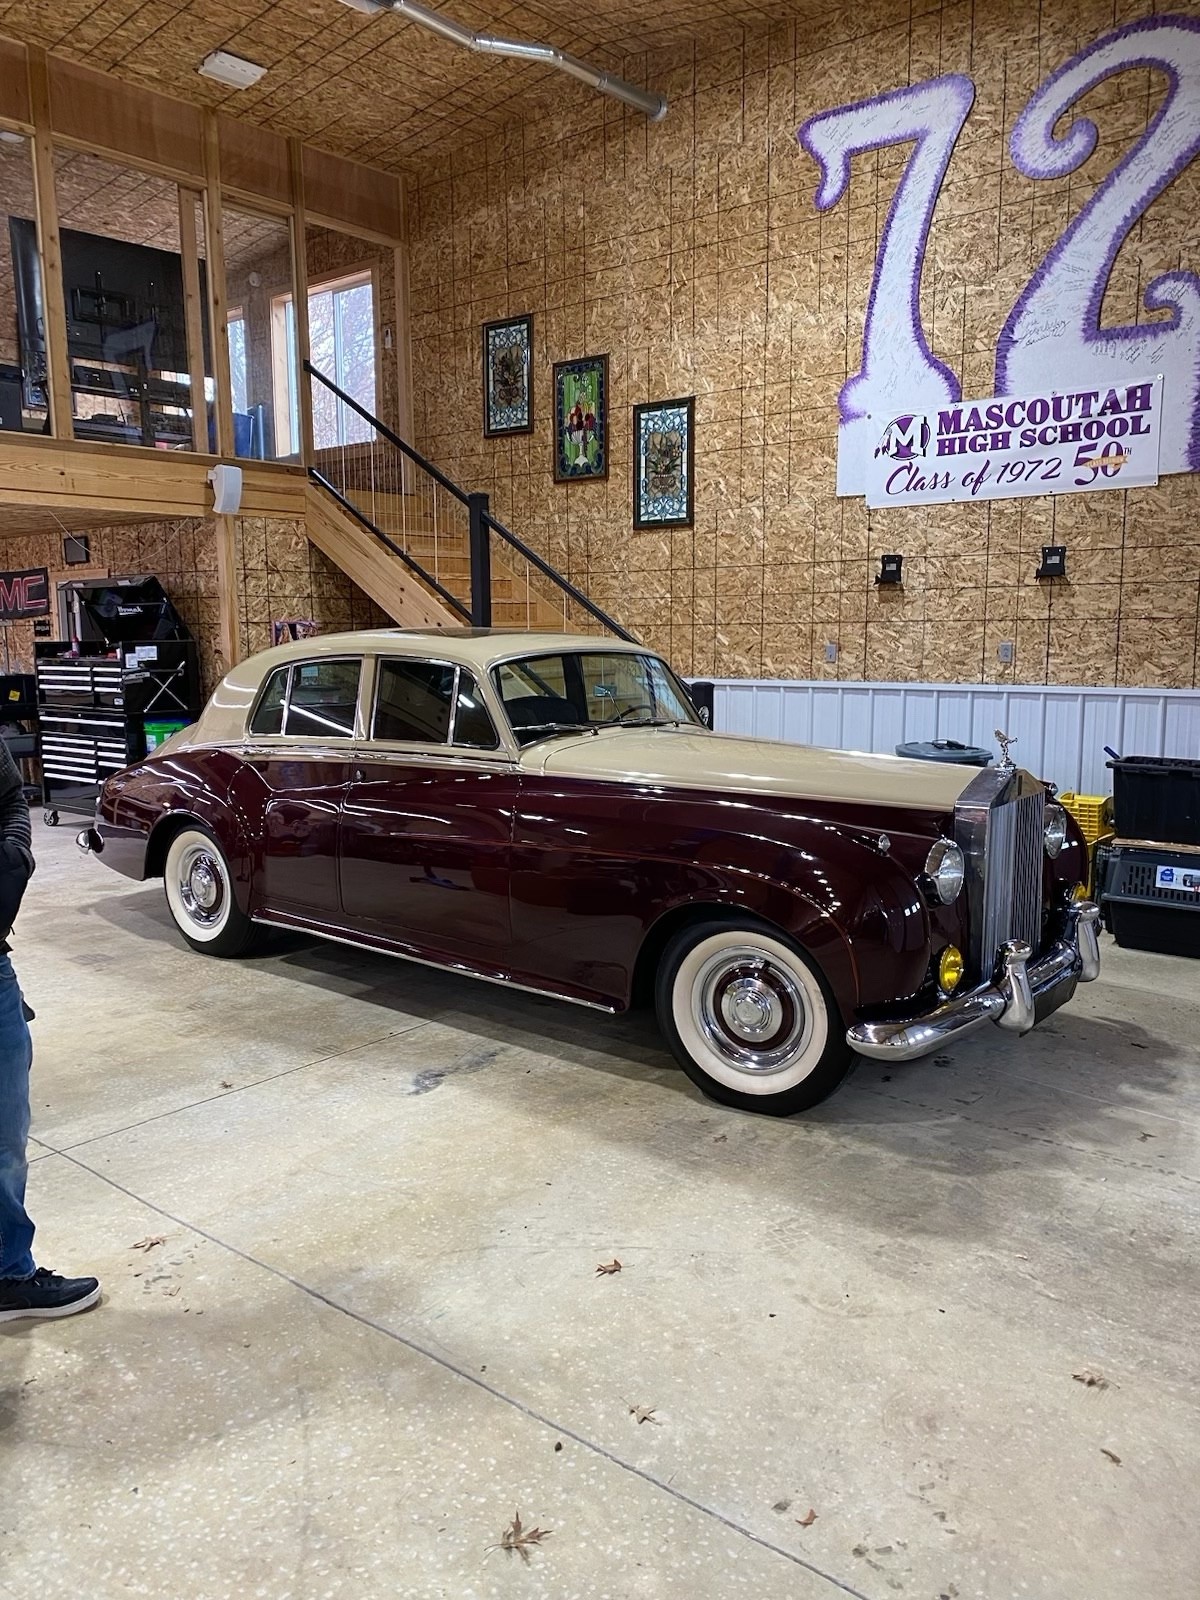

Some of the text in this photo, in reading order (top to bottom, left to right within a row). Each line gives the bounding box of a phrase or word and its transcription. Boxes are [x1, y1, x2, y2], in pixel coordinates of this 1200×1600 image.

[798, 15, 1200, 472] 72
[937, 383, 1153, 436] MASCOUTAH
[936, 415, 1151, 456] HIGH SCHOOL
[886, 457, 1062, 496] Class of 1972
